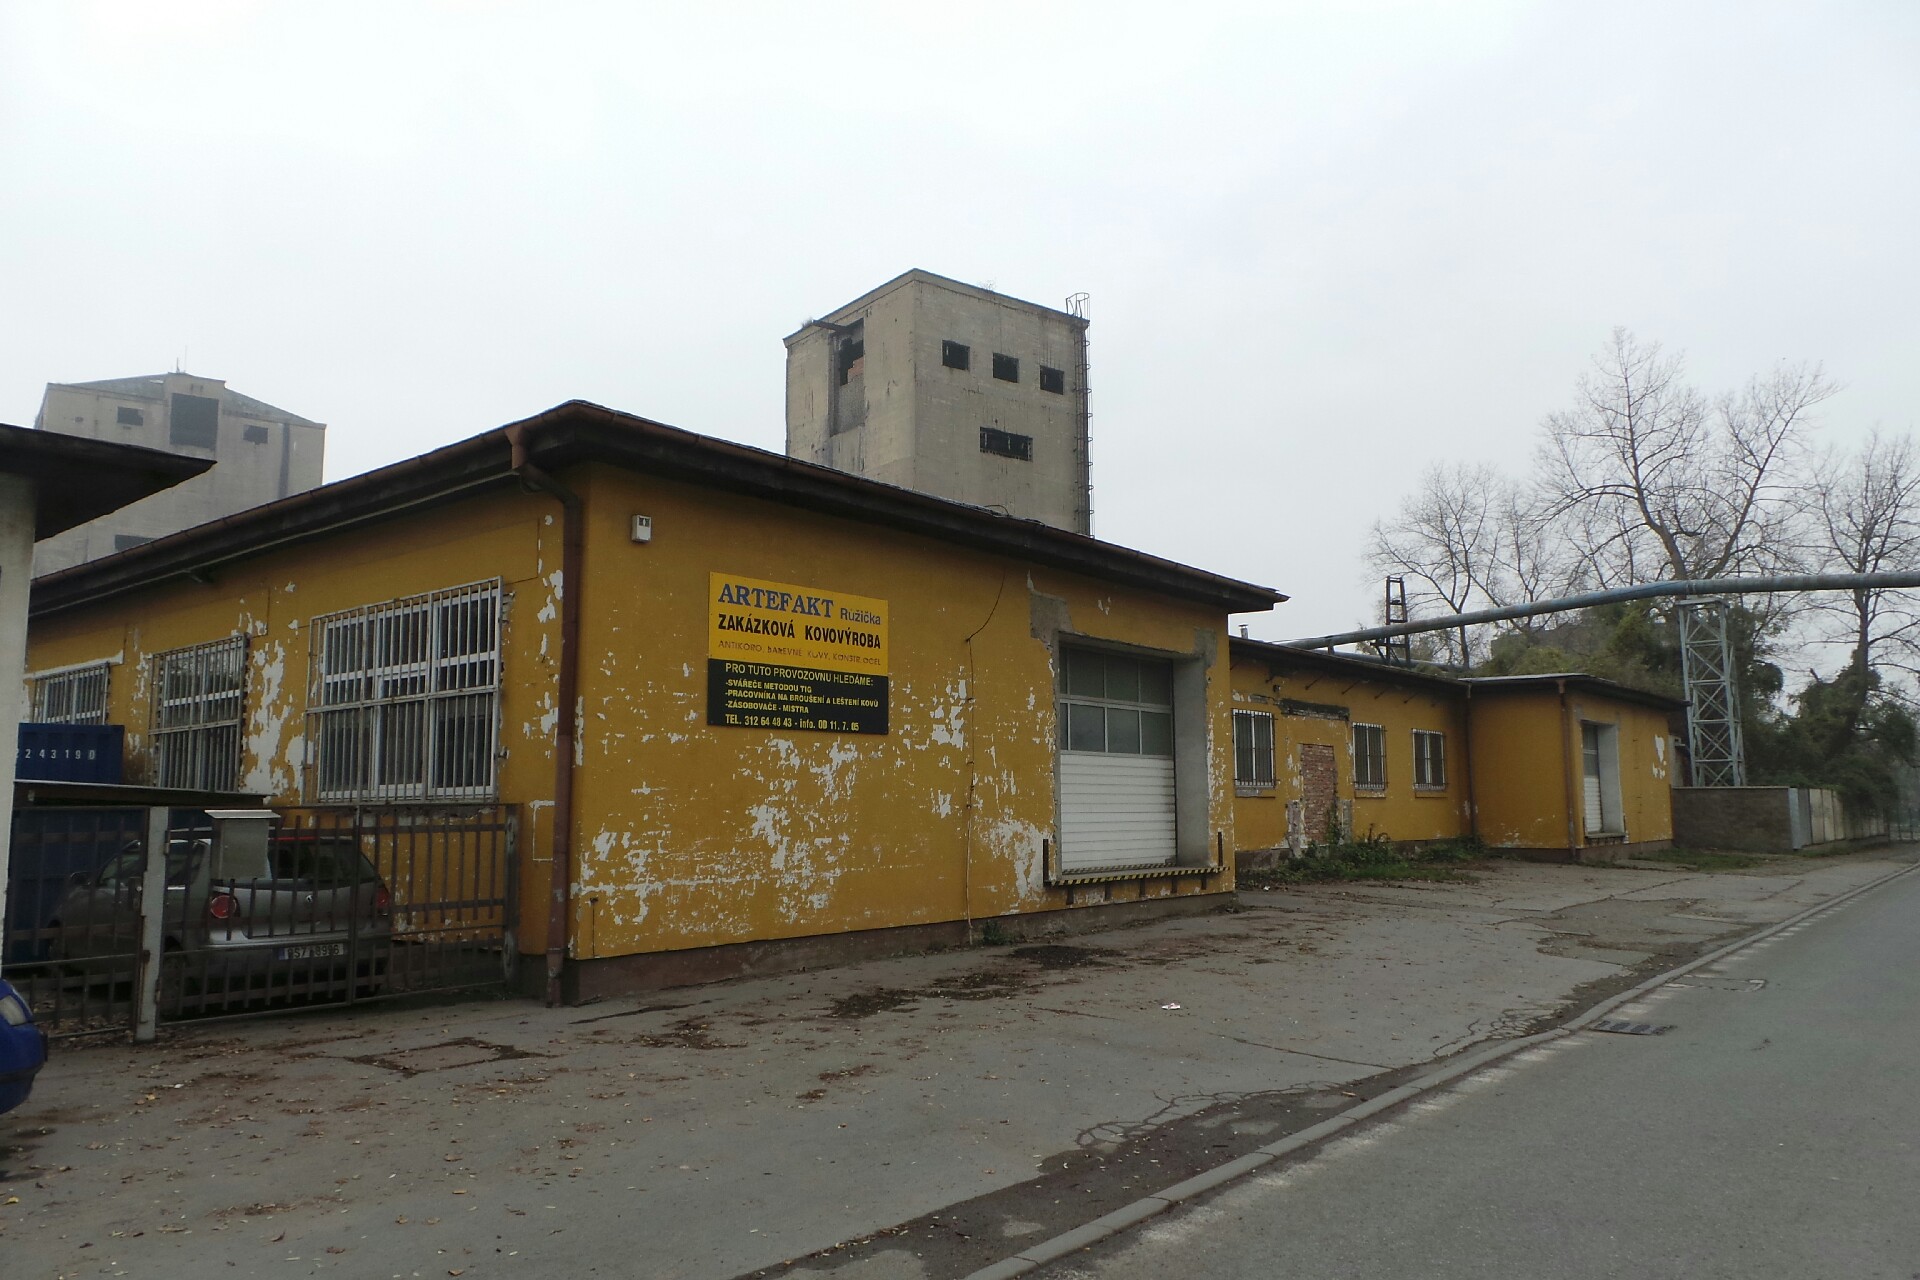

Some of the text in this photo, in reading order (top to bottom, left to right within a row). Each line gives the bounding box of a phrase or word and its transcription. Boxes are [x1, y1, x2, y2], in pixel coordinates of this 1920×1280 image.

[718, 583, 834, 618] ARTEFAKT
[718, 613, 881, 649] ZAKÁZKOVÁ KOVOVÝROBA
[725, 662, 874, 686] PRO TUTO PROVOZOVNU HLEDÁME:
[763, 682, 799, 692] METODOU
[777, 693, 788, 701] NA
[789, 694, 825, 704] BROUŠENÍ
[832, 696, 860, 706] LEŠTENÍ
[782, 704, 809, 714] MISTRA
[725, 713, 742, 725] TEL.
[744, 715, 758, 726] 312
[760, 716, 770, 726] 64
[772, 717, 781, 727] 48
[783, 717, 792, 728] 43
[799, 718, 816, 729] info.
